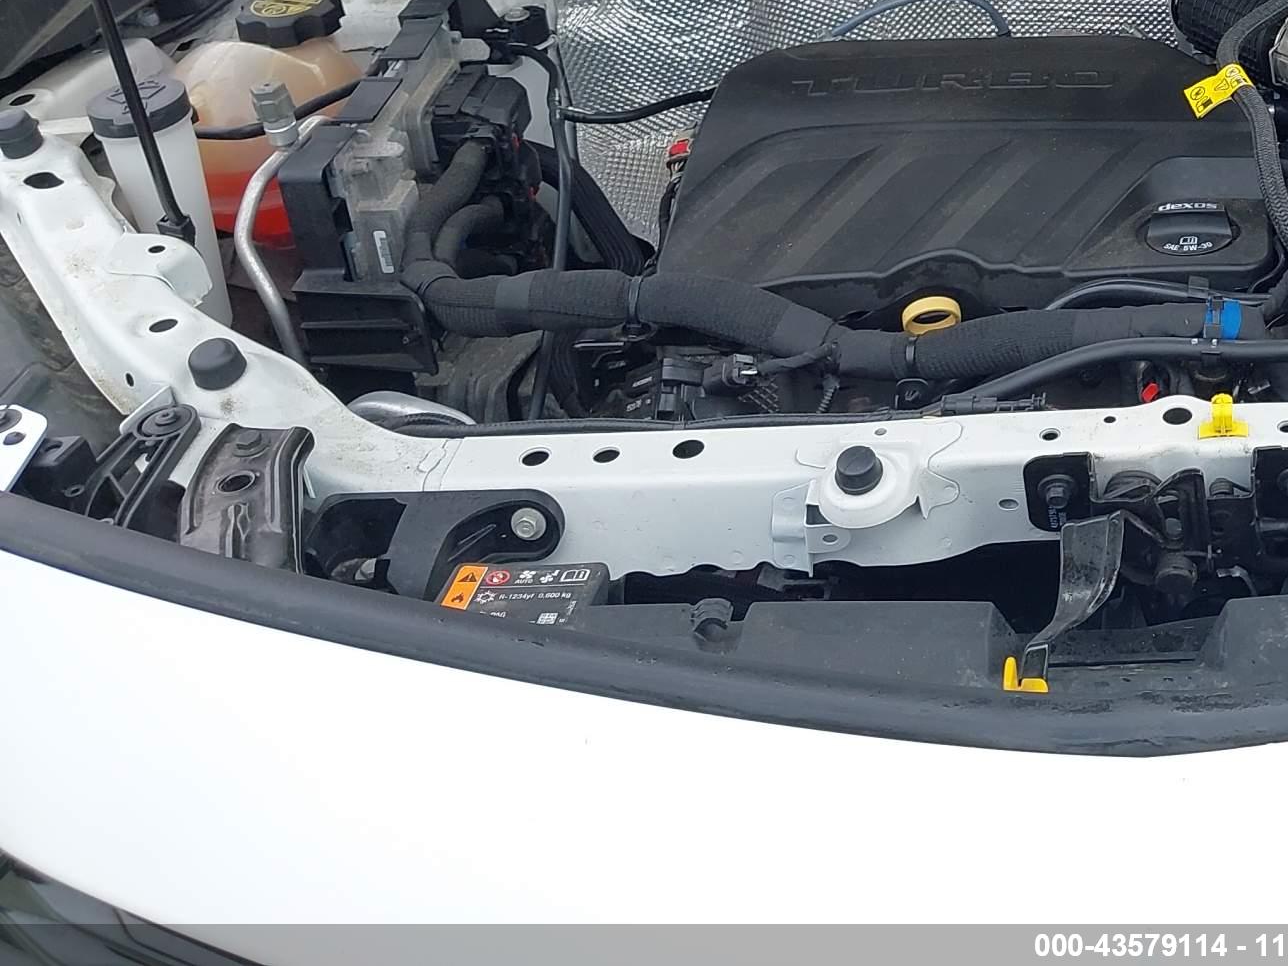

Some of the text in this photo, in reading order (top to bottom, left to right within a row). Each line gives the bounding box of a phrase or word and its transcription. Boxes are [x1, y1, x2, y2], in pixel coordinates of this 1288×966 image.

[791, 70, 1114, 96] TURBO
[1158, 202, 1217, 212] dexos
[1163, 242, 1180, 251] SAE
[498, 593, 535, 601] R-1234yf
